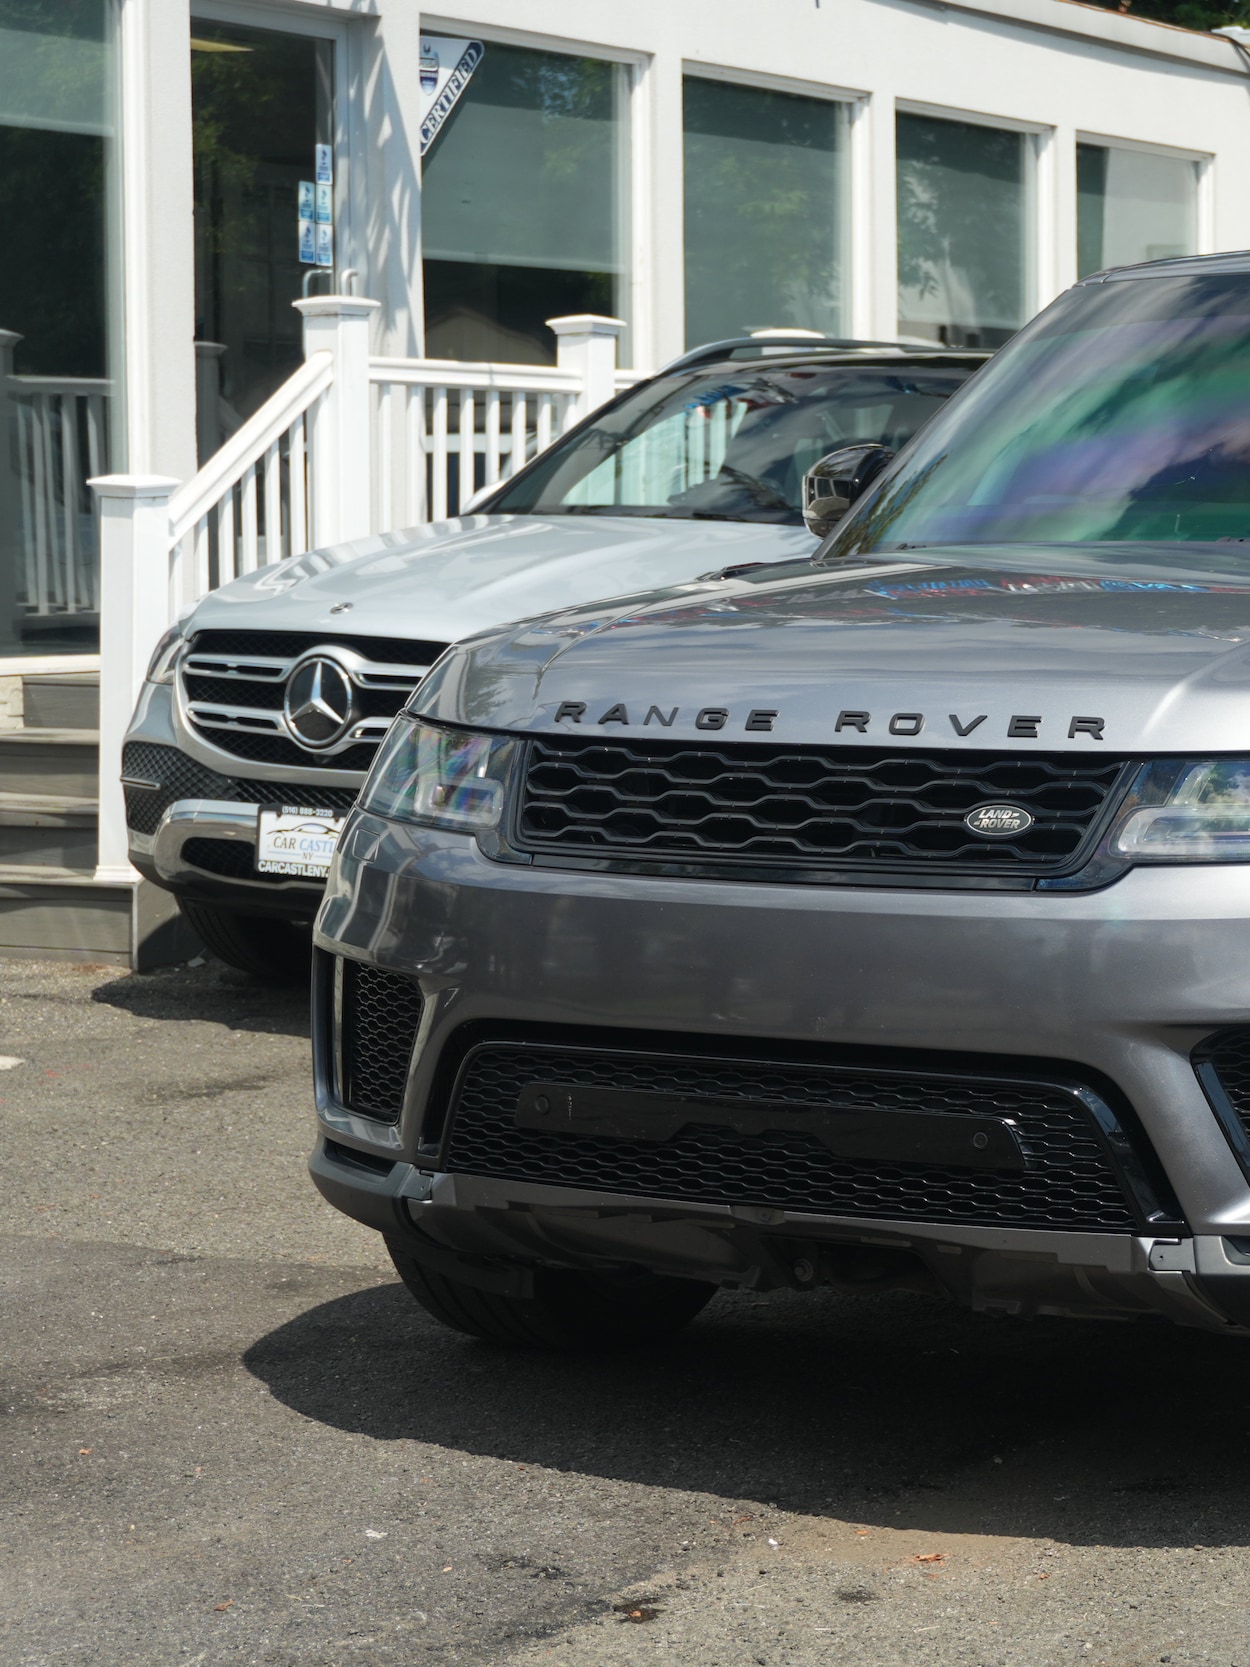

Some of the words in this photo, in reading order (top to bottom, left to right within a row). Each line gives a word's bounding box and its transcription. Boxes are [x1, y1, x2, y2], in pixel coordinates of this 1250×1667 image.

[420, 49, 478, 144] CERTIFIED
[554, 701, 780, 732] RANGE
[834, 710, 1106, 741] ROVER
[979, 809, 1013, 819] LAND
[979, 818, 1020, 829] ROVER
[273, 836, 296, 850] CAR
[300, 838, 334, 853] CASTL
[302, 852, 314, 861] NY
